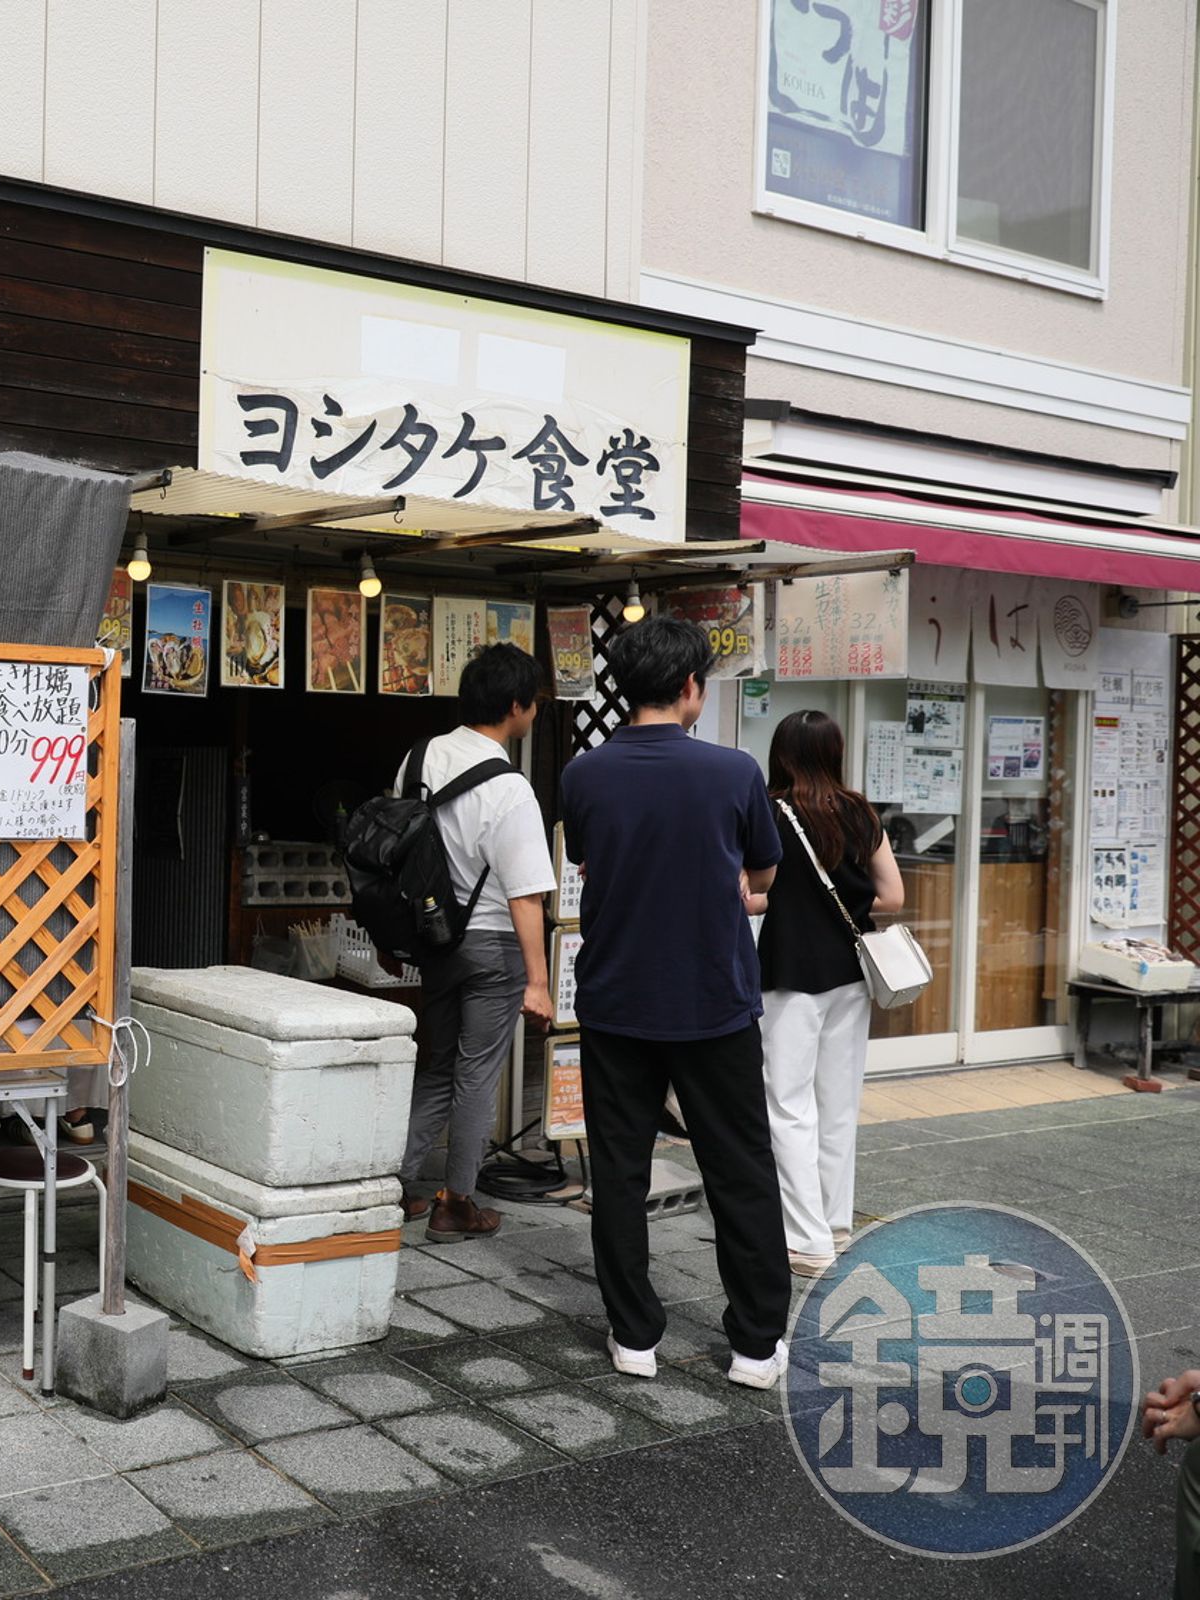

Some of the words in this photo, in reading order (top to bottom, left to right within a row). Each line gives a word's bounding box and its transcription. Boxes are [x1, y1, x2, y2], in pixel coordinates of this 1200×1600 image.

[237, 393, 660, 520] ヨシタケ食堂
